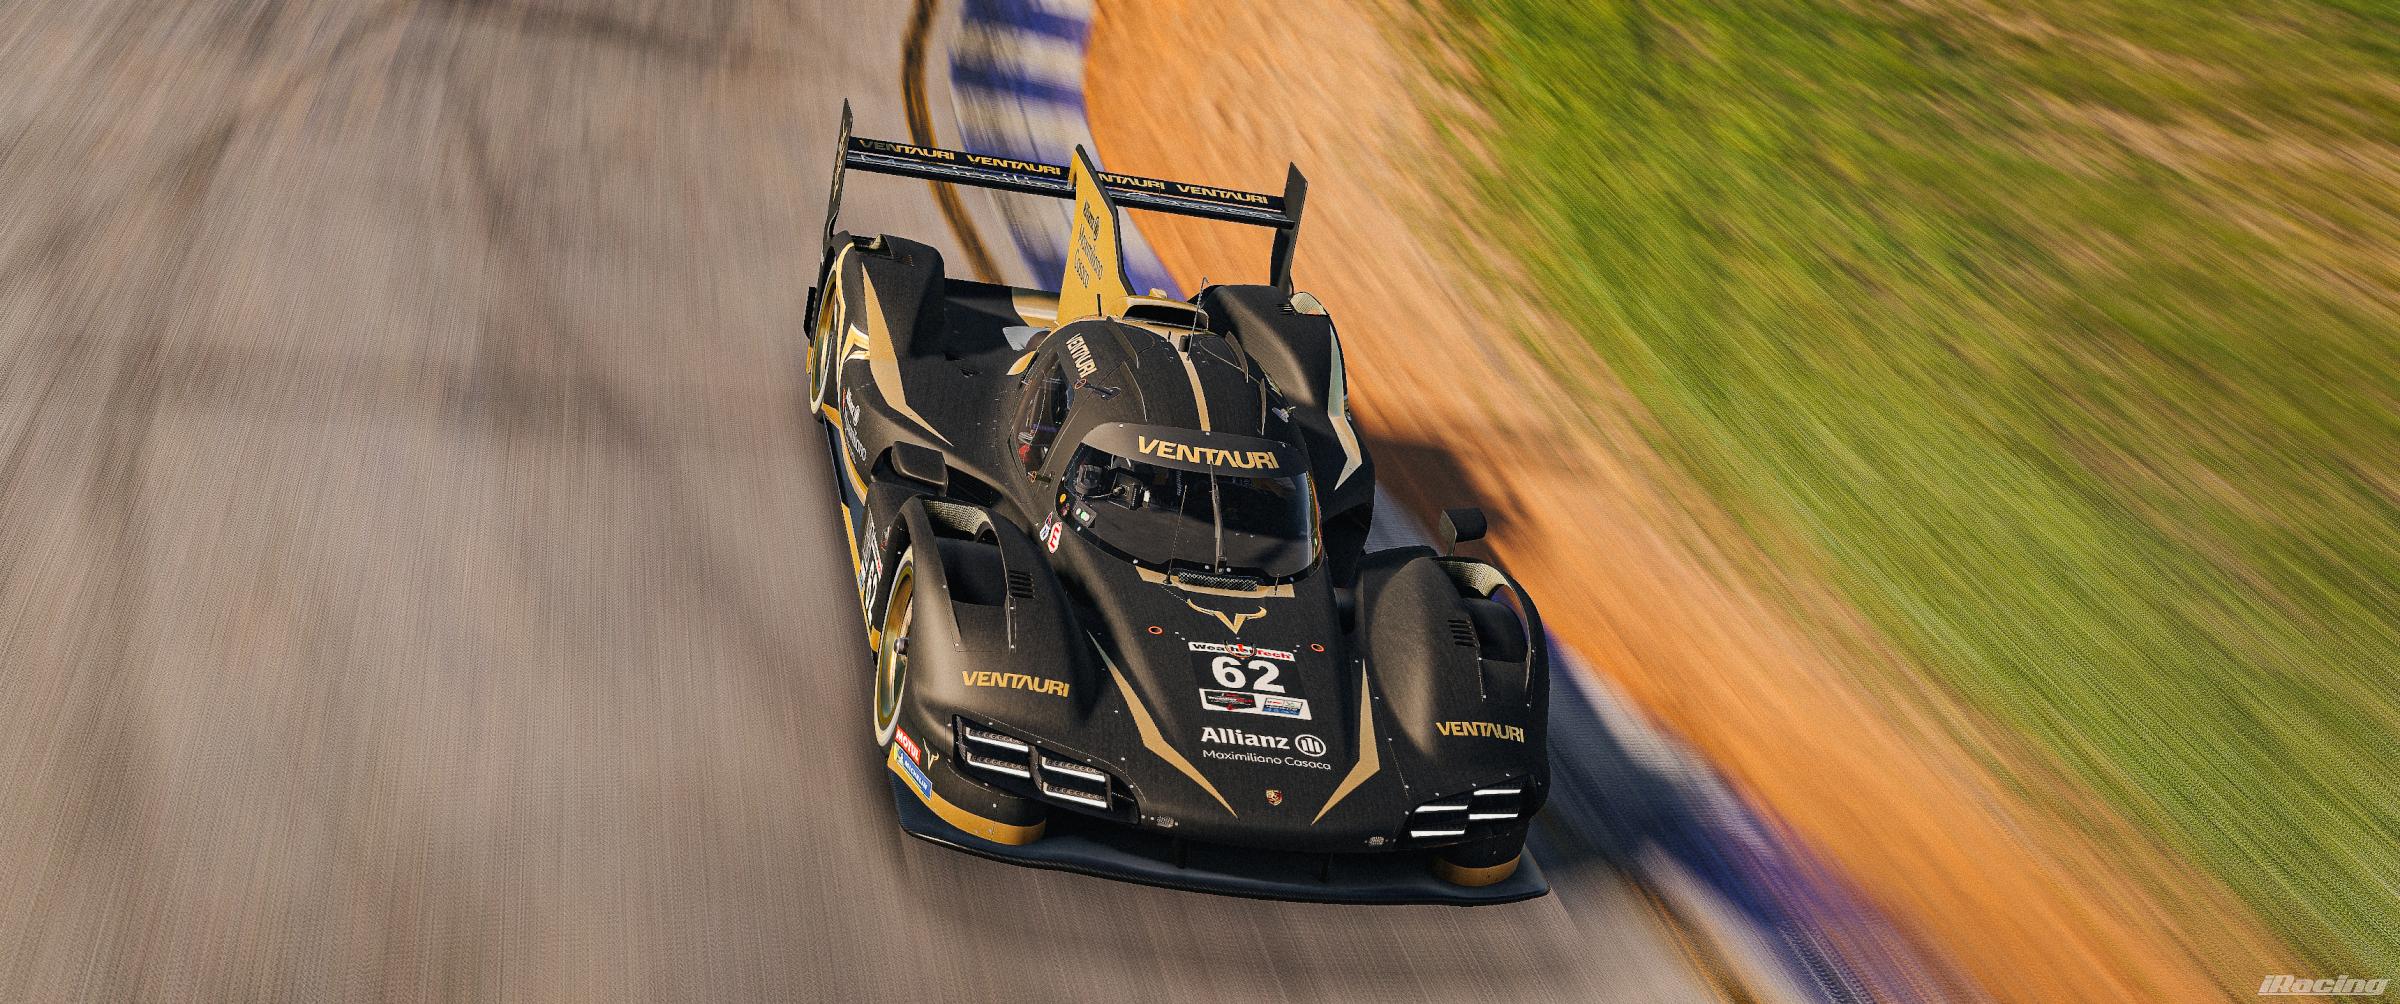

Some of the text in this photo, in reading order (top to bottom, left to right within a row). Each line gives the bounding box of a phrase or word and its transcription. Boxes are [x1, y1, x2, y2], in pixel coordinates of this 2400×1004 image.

[859, 140, 955, 161] VENTAURI
[966, 154, 1062, 176] VENTAURI
[1098, 173, 1166, 190] NTAURI
[1176, 184, 1269, 205] VENTAURI
[1066, 333, 1098, 379] VENTAURI
[1138, 435, 1279, 469] VENTAURI
[1192, 643, 1292, 660] WeahrTech
[962, 671, 1070, 698] VENTAURI
[1212, 656, 1286, 693] 62
[1201, 727, 1290, 750] Allianz
[1435, 721, 1524, 743] VENTAURI
[895, 729, 920, 763] MOTUL
[1202, 750, 1331, 771] Maximiliano Casaca
